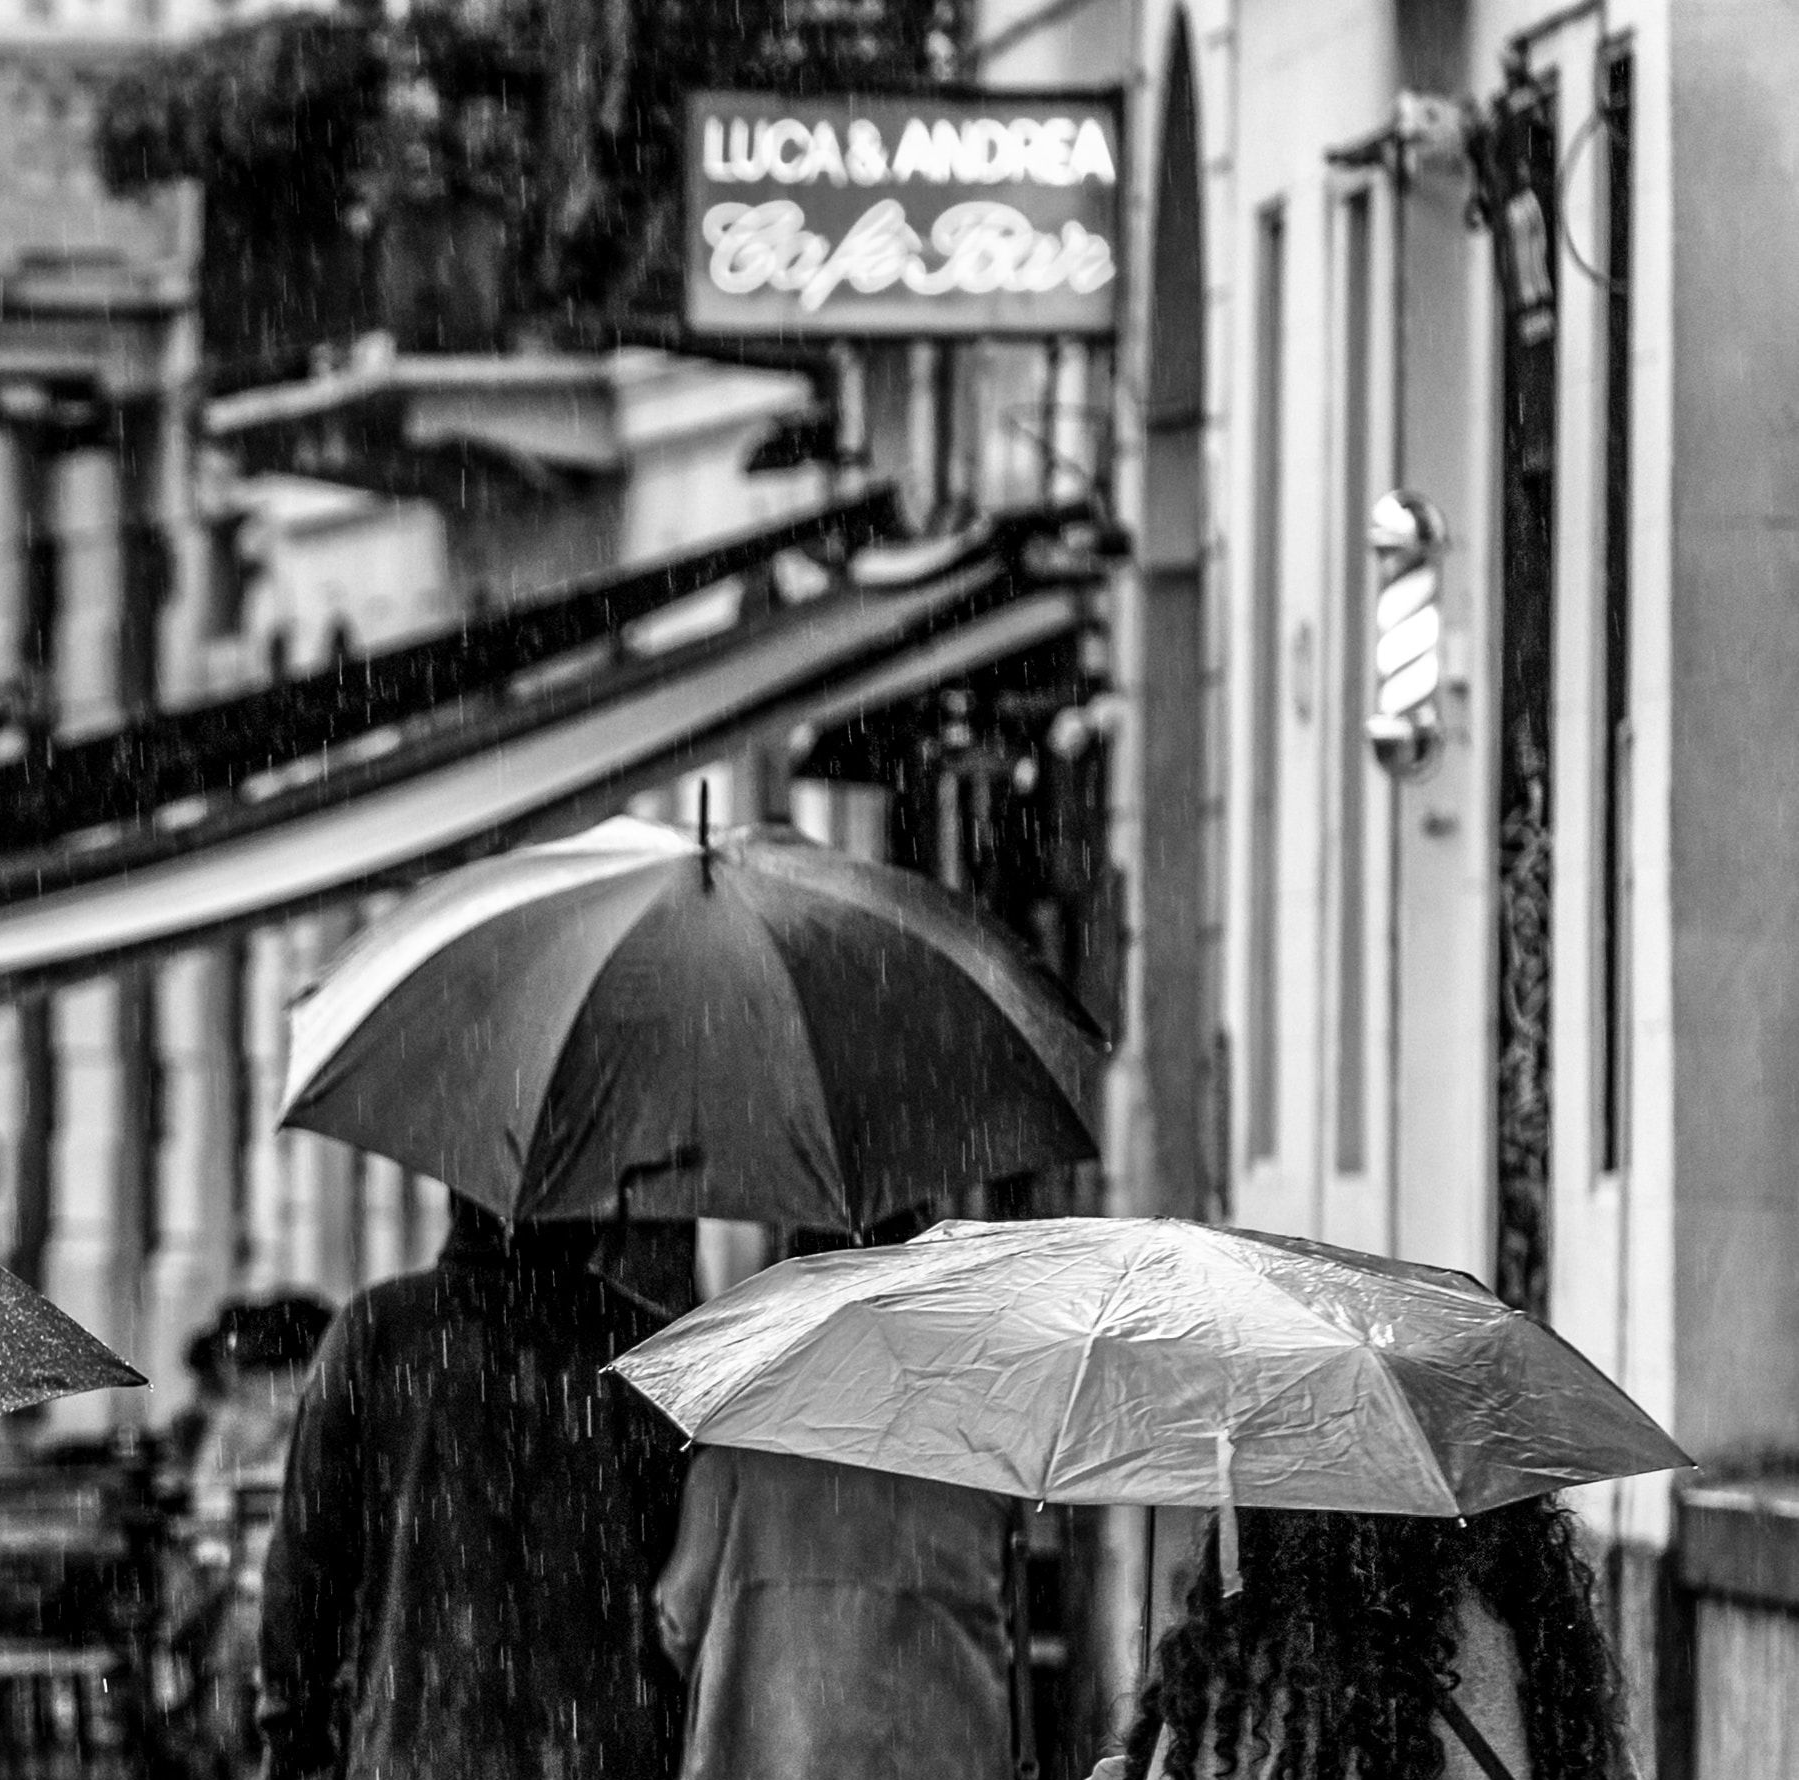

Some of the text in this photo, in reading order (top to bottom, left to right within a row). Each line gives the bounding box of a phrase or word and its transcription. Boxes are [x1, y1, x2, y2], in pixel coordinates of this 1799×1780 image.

[703, 115, 1117, 187] LUCA & ANDREA
[904, 200, 1117, 295] Bar
